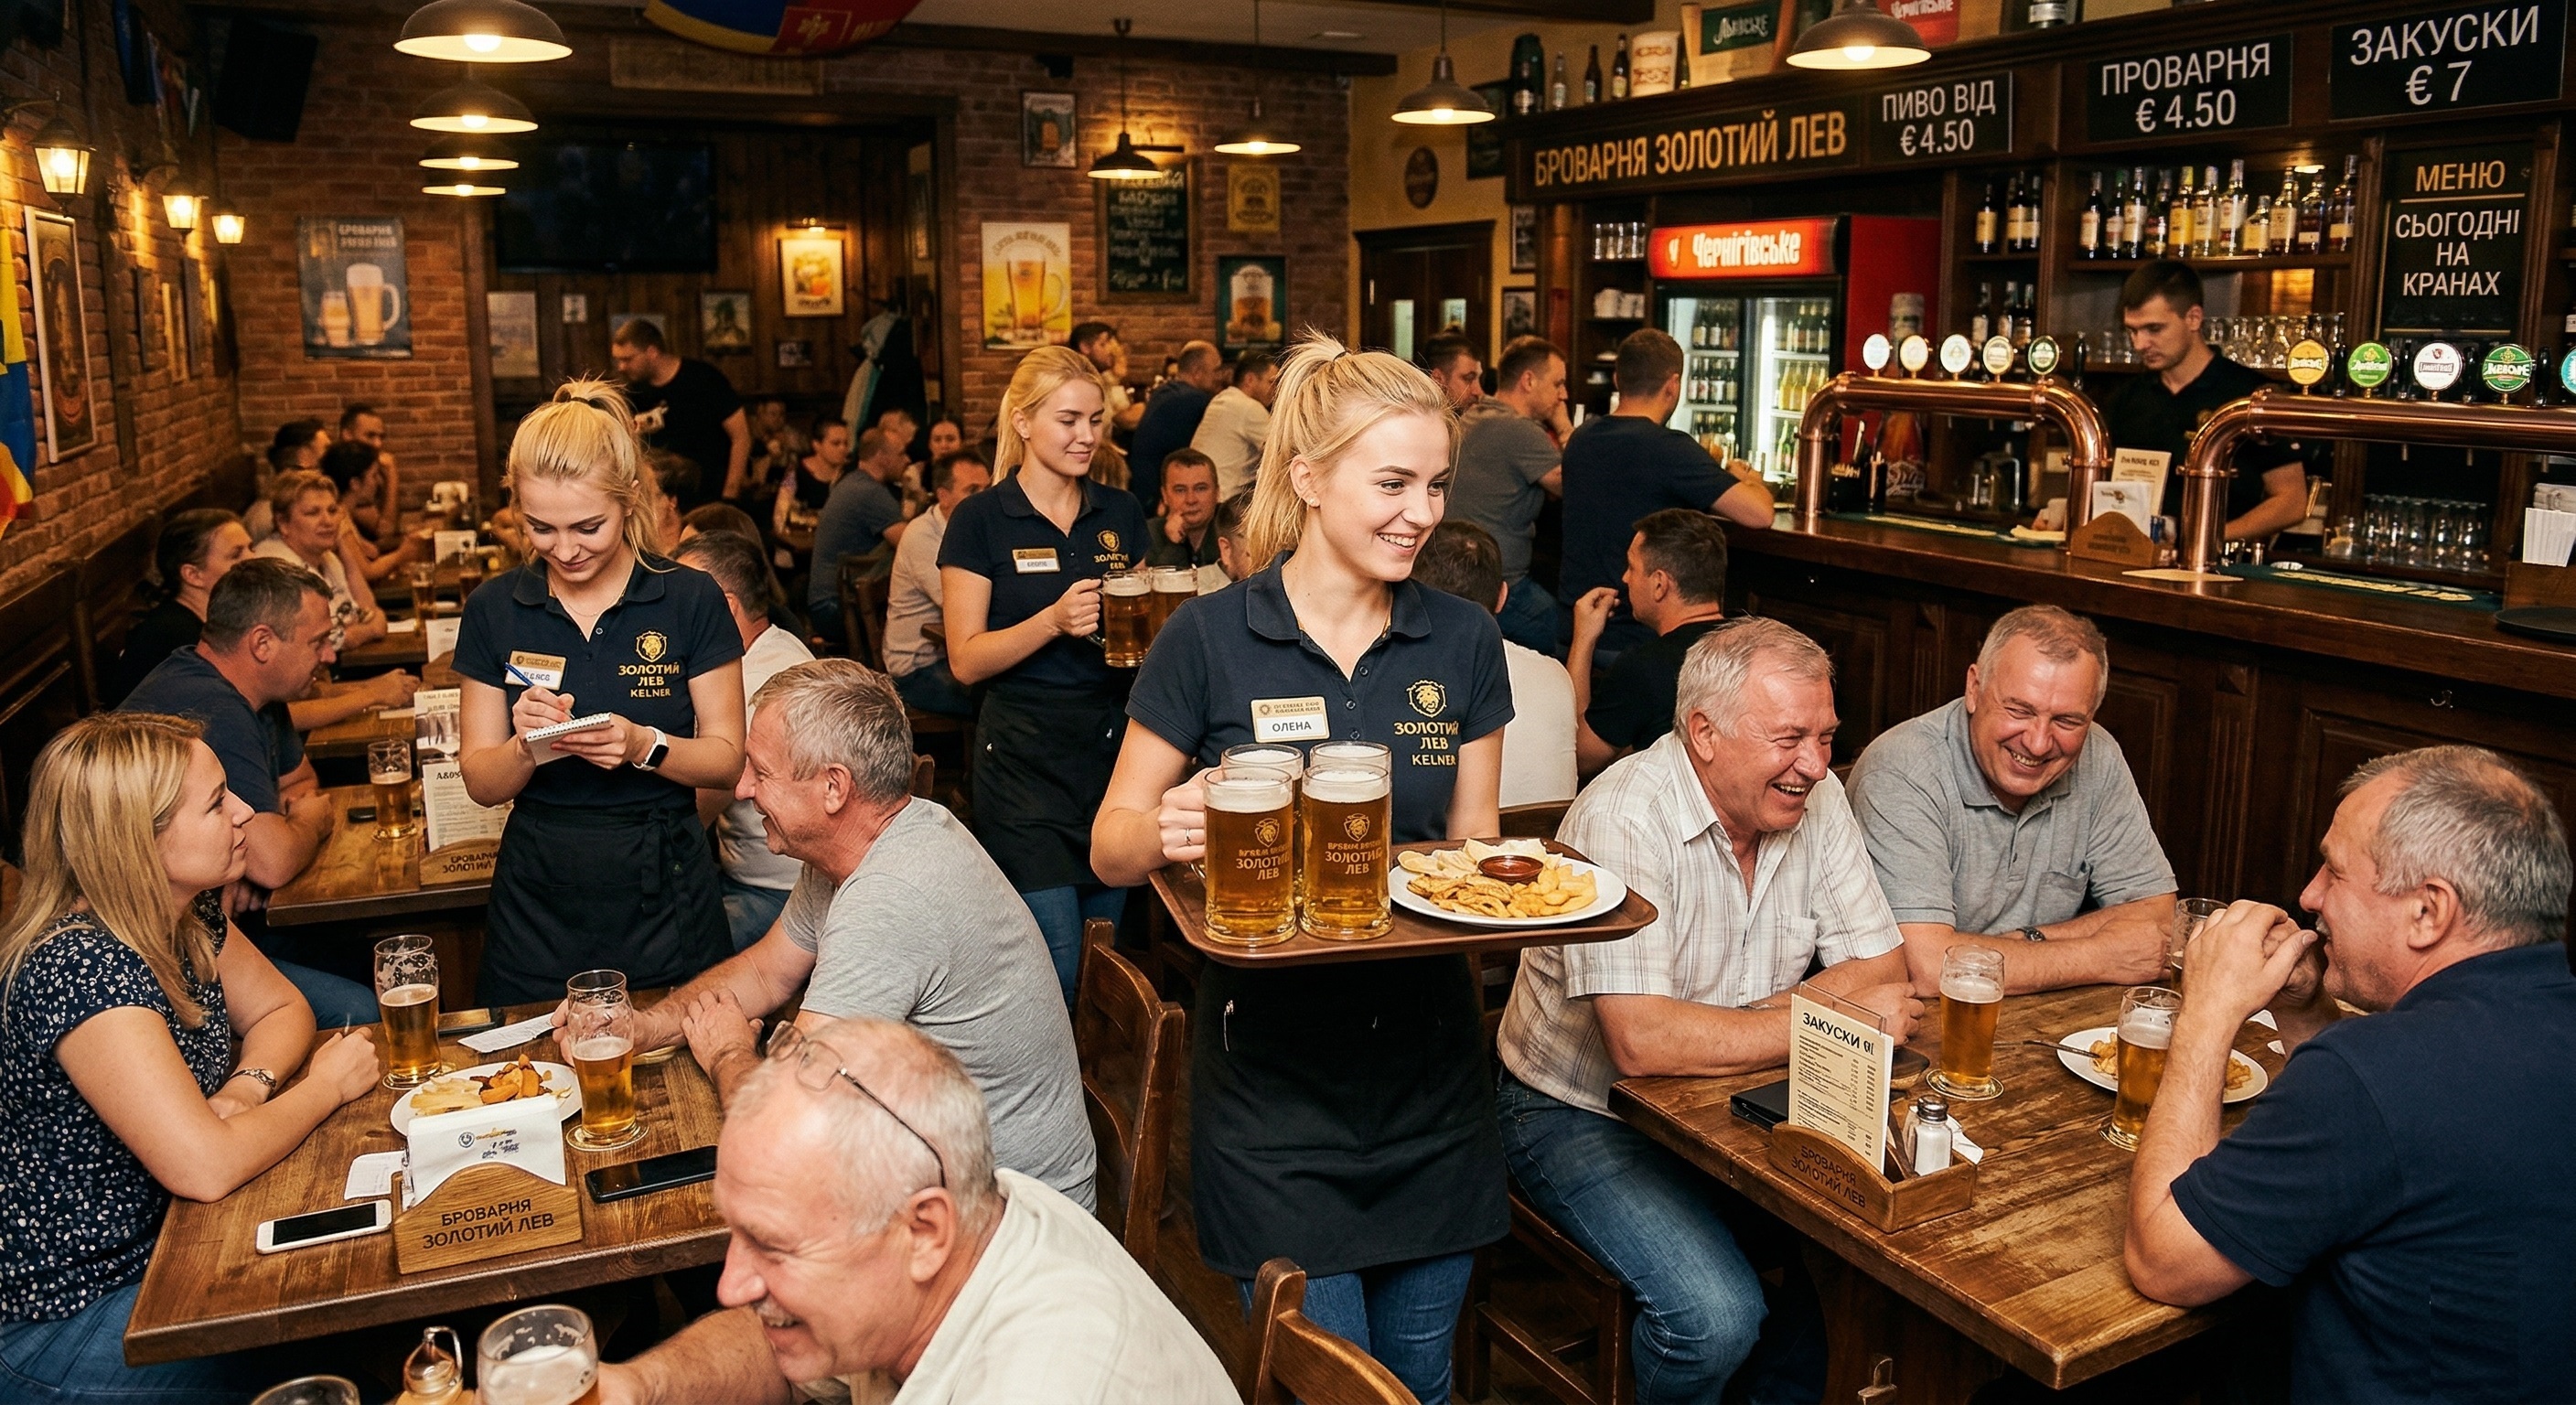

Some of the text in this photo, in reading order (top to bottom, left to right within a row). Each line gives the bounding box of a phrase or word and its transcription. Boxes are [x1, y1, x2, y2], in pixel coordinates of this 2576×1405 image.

[2350, 5, 2539, 66] ЗАКУСКИ
[2102, 42, 2270, 96] ПРОВАРНЯ
[2405, 60, 2472, 106] € 7
[1883, 80, 1996, 122] ПИВО ВІД
[2135, 89, 2236, 133] € 4.50
[1534, 109, 1847, 188] БРОВАРНЯ ЗОЛОТИЙ ЛЕВ
[2416, 160, 2506, 192] МЕНЮ
[2395, 209, 2520, 241] СЬОГОДНІ
[2436, 241, 2470, 266] НА
[2402, 271, 2501, 296] КРАНАХ
[617, 661, 680, 676] ЗОЛОТИЙ
[638, 676, 665, 686] ЛЕВ
[630, 688, 671, 698] KELNER
[1272, 721, 1312, 732] ОЛЕНА
[1420, 737, 1448, 749] ЛЕВ
[1257, 867, 1280, 881] ЛЕВ
[1346, 863, 1369, 874] ЛЕВ
[1843, 1186, 1865, 1207] ЛЕВ
[442, 1198, 531, 1227] БРОВАРНЯ
[423, 1213, 554, 1249] ЗОЛОТИЙ ЛЕВ
